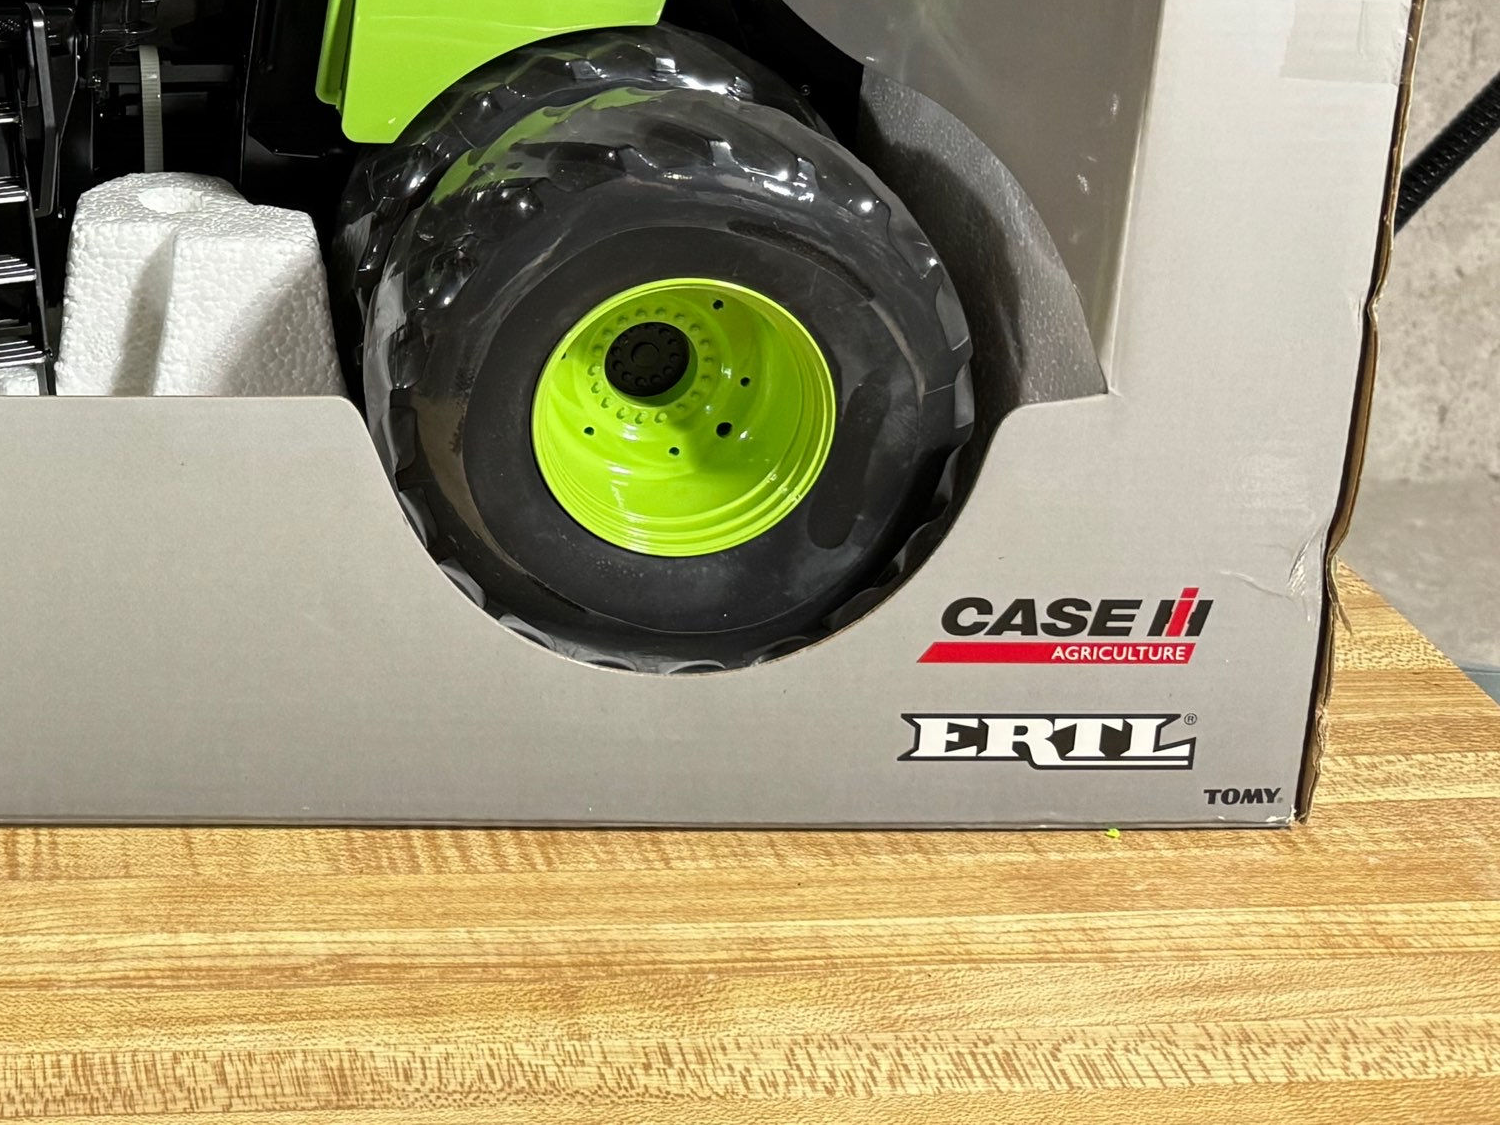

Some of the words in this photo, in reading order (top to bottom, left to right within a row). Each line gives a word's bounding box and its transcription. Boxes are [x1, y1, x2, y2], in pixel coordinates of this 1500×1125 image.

[941, 596, 1143, 637] CASE
[1051, 645, 1186, 661] AGRICULTURE
[1203, 787, 1282, 805] TOMY
